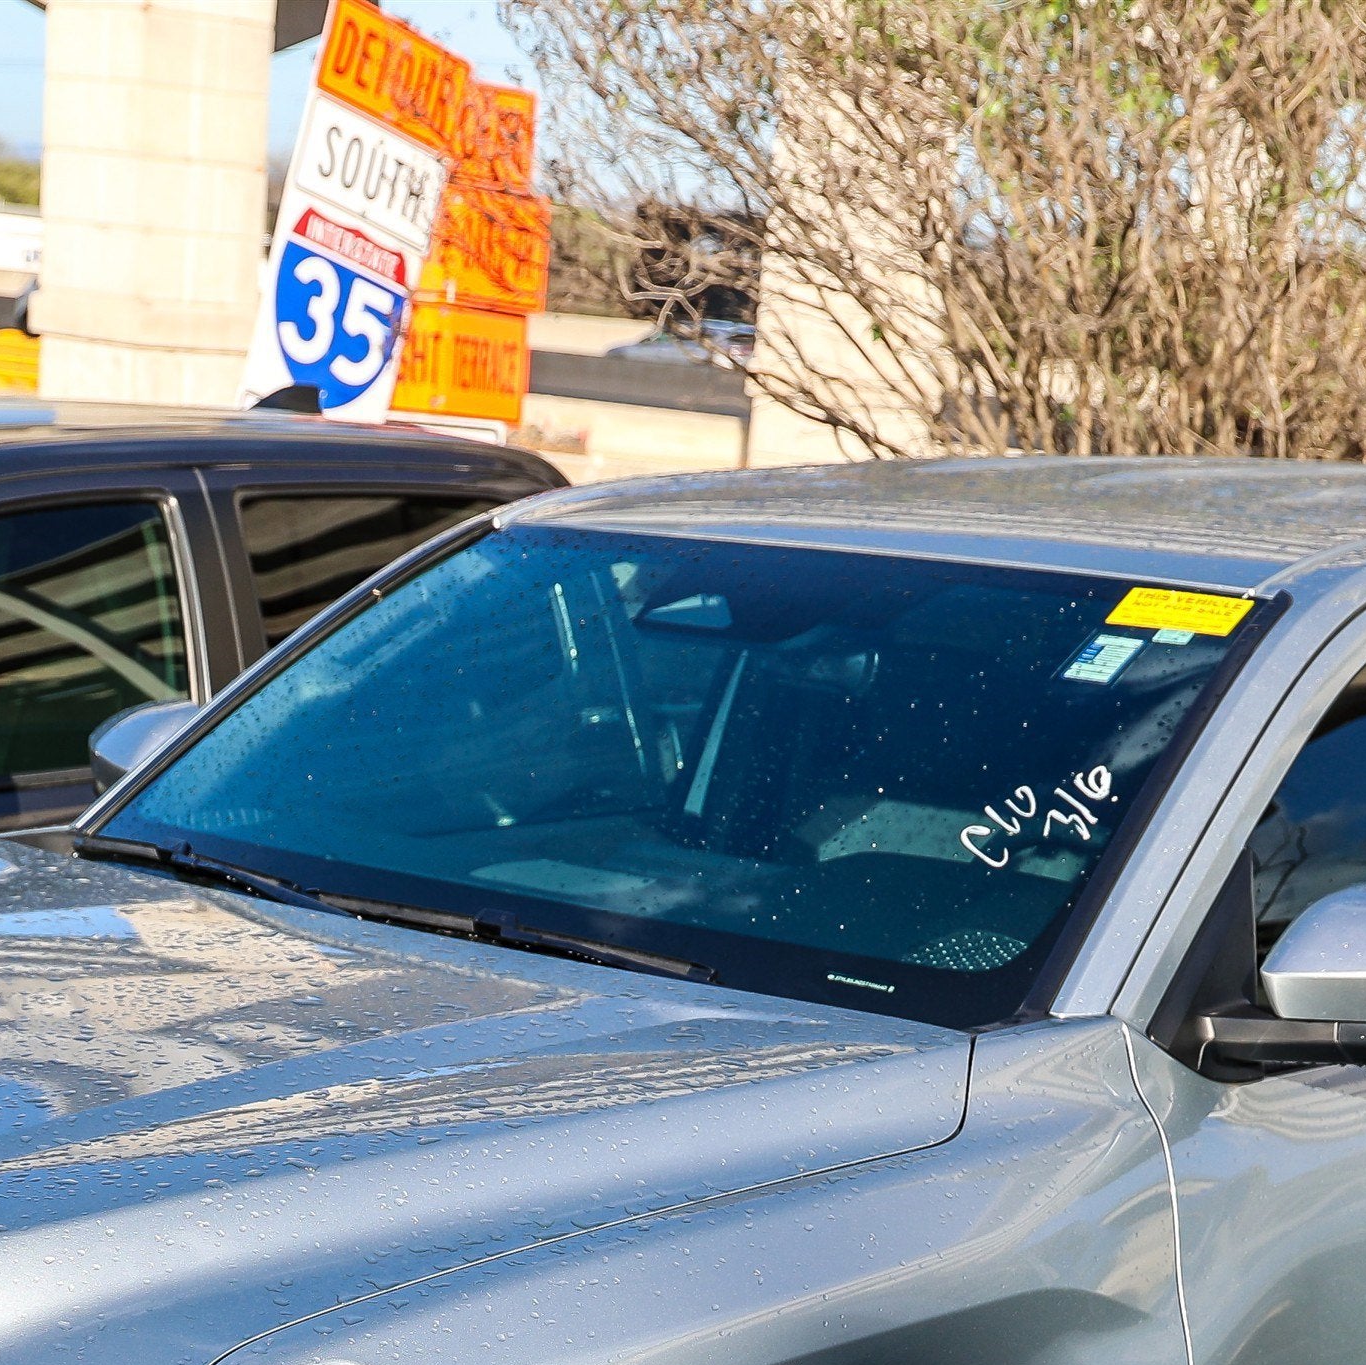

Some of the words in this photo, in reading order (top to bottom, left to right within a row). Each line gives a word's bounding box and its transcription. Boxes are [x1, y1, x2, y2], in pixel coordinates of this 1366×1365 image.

[318, 125, 429, 223] SOUTH
[278, 255, 395, 387] 35
[1136, 590, 1172, 601] THIS
[1176, 594, 1244, 611] VEHICLE
